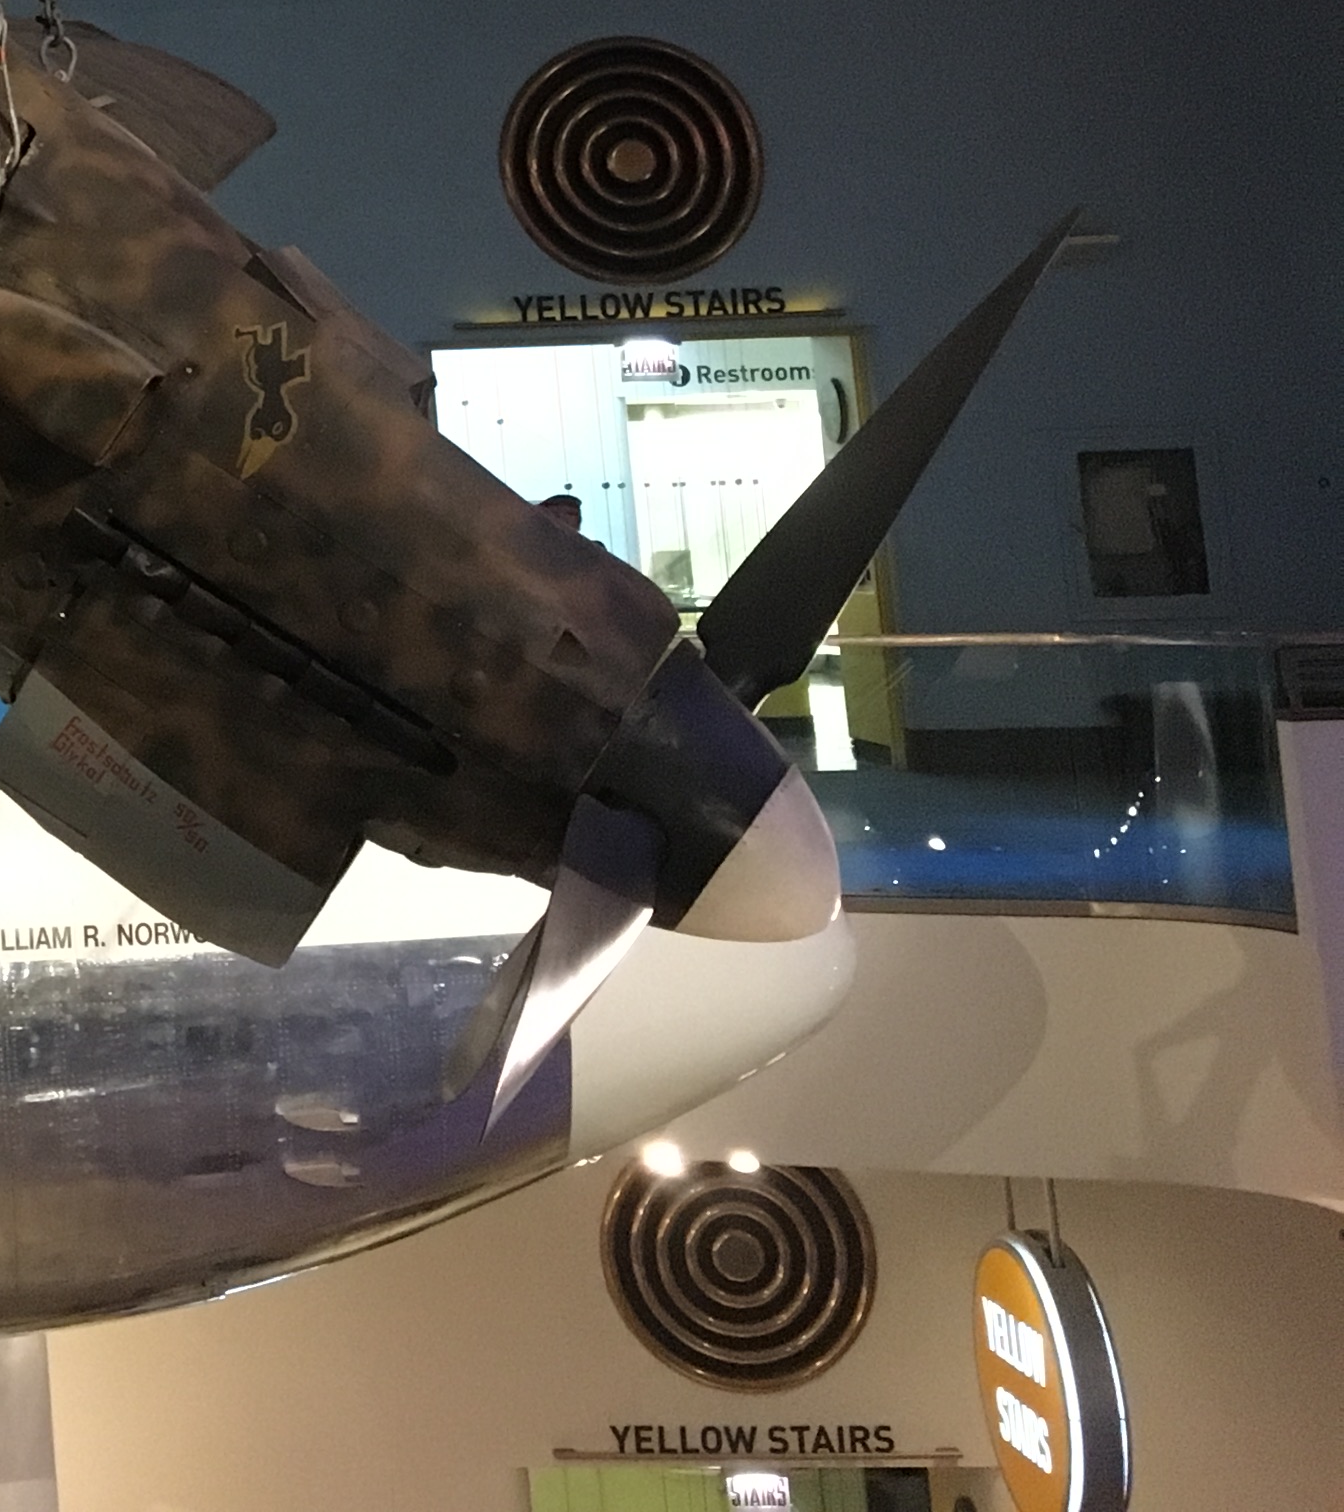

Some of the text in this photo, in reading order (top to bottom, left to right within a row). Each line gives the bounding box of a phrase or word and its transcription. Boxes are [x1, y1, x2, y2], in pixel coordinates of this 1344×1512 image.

[513, 287, 787, 323] YELLOW STAIRS
[83, 924, 106, 948] R.
[116, 922, 208, 947] NORW
[981, 1296, 1047, 1388] YELLOW
[609, 1424, 896, 1455] YELLOW STAIRS
[996, 1386, 1053, 1475] STAIRS
